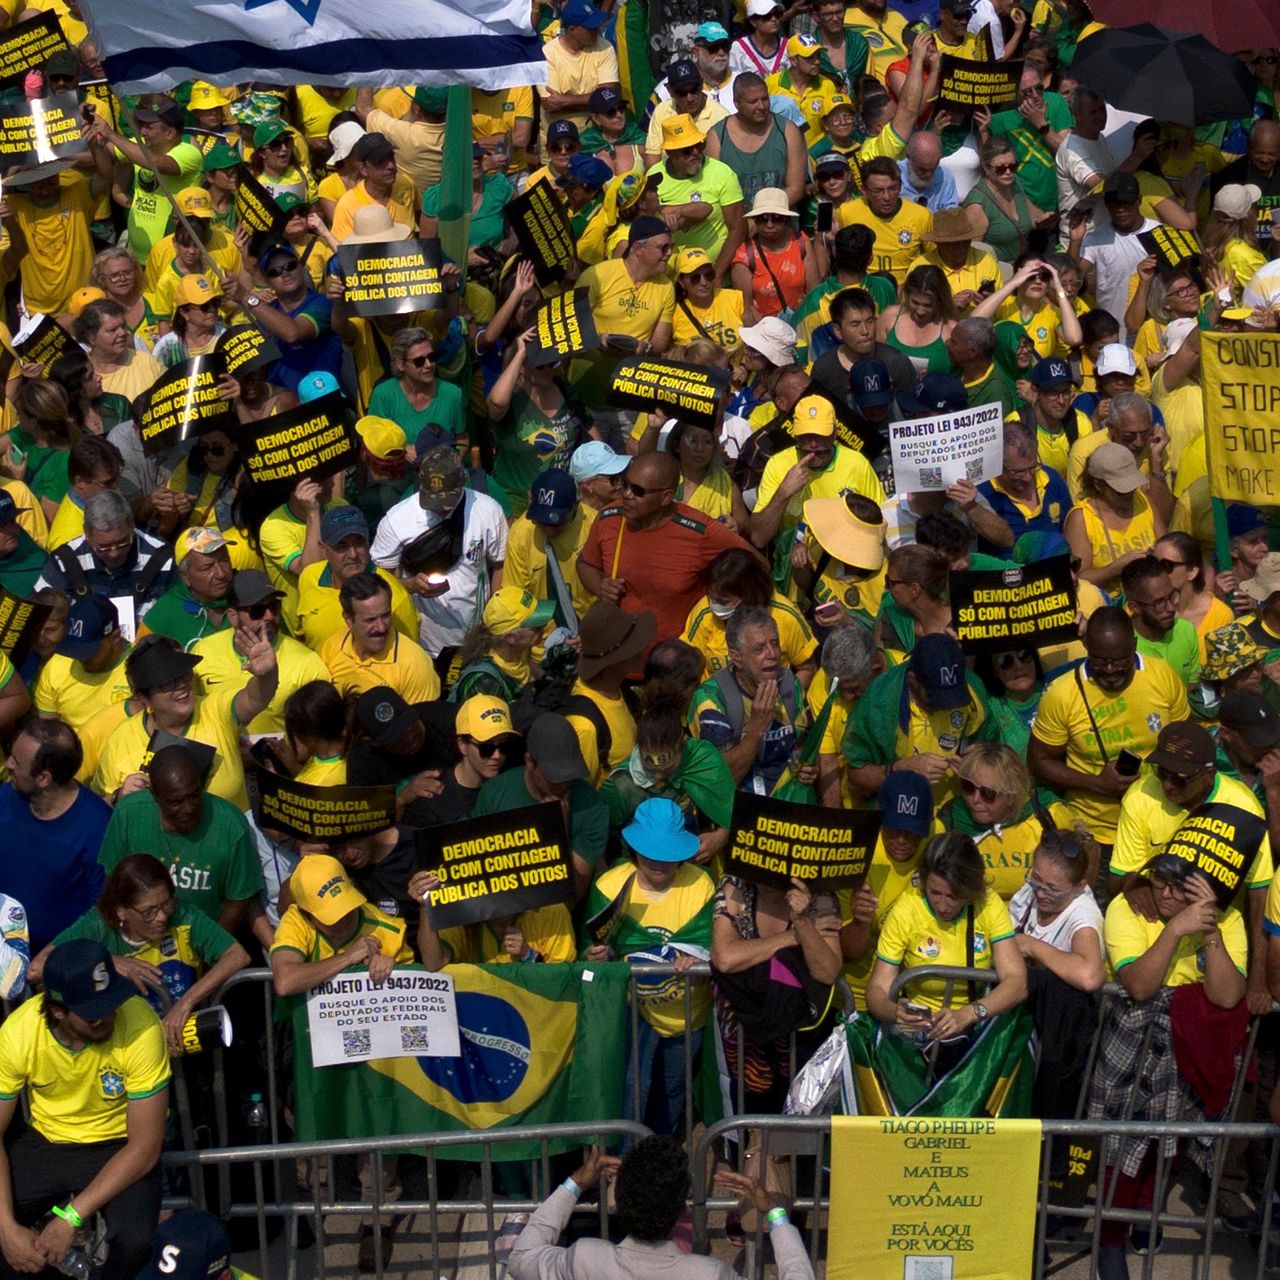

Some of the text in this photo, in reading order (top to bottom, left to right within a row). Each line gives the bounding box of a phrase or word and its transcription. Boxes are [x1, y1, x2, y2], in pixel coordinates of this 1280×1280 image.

[357, 254, 424, 271] DEMOCRACIA
[346, 268, 438, 288] SÓ COM CONTAGEM
[345, 282, 442, 302] PÚBLICA DOS VOTOS!
[620, 366, 715, 399] SÓ COM CONTAGEM
[639, 361, 708, 384] DEMOCRACIA
[613, 379, 714, 416] PÚBLICA DOS VOTOS!
[255, 414, 330, 451] DEMOCRACIA
[893, 408, 999, 439] PROJETO LEI 943/2022
[248, 424, 345, 470] SÓ COM CONTAGEM
[900, 440, 938, 450] BUSQUE
[949, 432, 977, 443] APOIO
[979, 426, 996, 436] DOS
[900, 434, 997, 458] DEPUTADOS FEDERAIS
[251, 438, 351, 483] PÚBLICA DOS VOTOS!
[931, 455, 948, 463] SEU
[951, 446, 984, 460] ESTADO
[1225, 465, 1274, 497] MAKE
[540, 488, 556, 507] M
[973, 577, 1053, 604] DEMOCRACIA
[959, 592, 1070, 622] SÓ COM CONTAGEM
[959, 609, 1075, 641] PÚBLICA DOS VOTOS!
[897, 795, 919, 816] M
[756, 816, 853, 843] DEMOCRACIA
[442, 827, 540, 861] DEMOCRACIA
[736, 829, 866, 862] SÓ COM CONTAGEM
[431, 845, 560, 883] SÓ COM CONTAGEM
[731, 845, 866, 878] PÚBLICA DOS VOTOS!
[430, 864, 568, 907] PÚBLICA DOS VOTOS!
[92, 962, 111, 992] S
[311, 978, 362, 997] PROJETO
[387, 976, 450, 993] 943/2022
[319, 995, 445, 1010] BUSQUE O APOIO DOS
[319, 1005, 447, 1019] DEPUTADOS FEDERAIS
[337, 1013, 428, 1027] DO SEU ESTADO
[881, 1121, 996, 1135] TIAGO PHELIPE
[904, 1137, 971, 1150] GABRIEL
[931, 1151, 942, 1164] E
[903, 1166, 969, 1178] MATEUS
[928, 1181, 941, 1193] A
[888, 1192, 983, 1207] VOVÓ MALU
[892, 1221, 971, 1237] ESTÁ AQUI
[887, 1237, 974, 1251] POR VOCÊS
[158, 1244, 181, 1274] S
